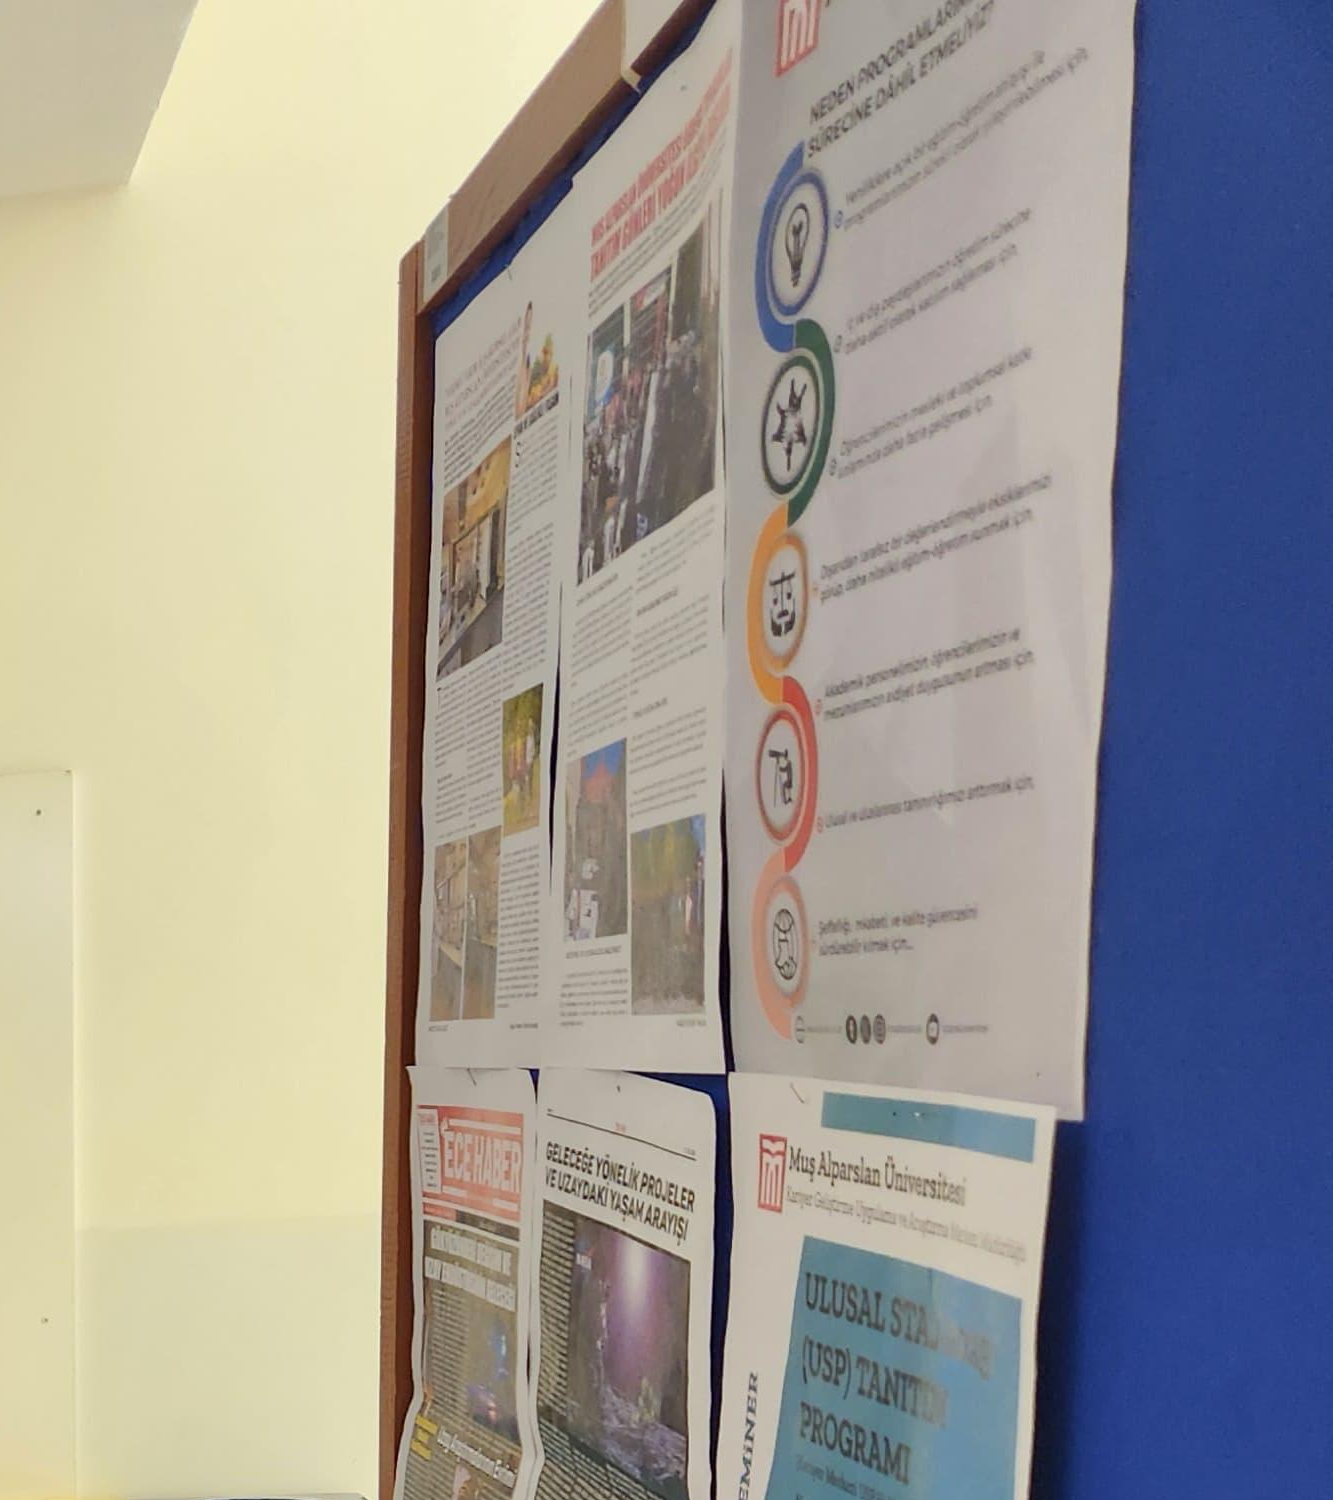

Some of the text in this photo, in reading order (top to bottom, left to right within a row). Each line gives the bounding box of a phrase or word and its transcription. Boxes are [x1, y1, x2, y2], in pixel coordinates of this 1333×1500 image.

[809, 75, 855, 125] NEDEN
[856, 0, 965, 91] PROGRAMLAR
[808, 95, 873, 158] SÜRECİNE
[544, 1167, 689, 1247] VE UZAYDAKİ YAŞAM ARAYIŞI
[545, 1141, 695, 1213] GELECEĞE YÖNELİK PROJELER
[789, 1145, 967, 1208] Muş Alparslan Üniversitesi
[804, 1271, 886, 1335] ULUSAL
[802, 1336, 853, 1400] (USP)
[799, 1400, 913, 1487] PROGRAMI
